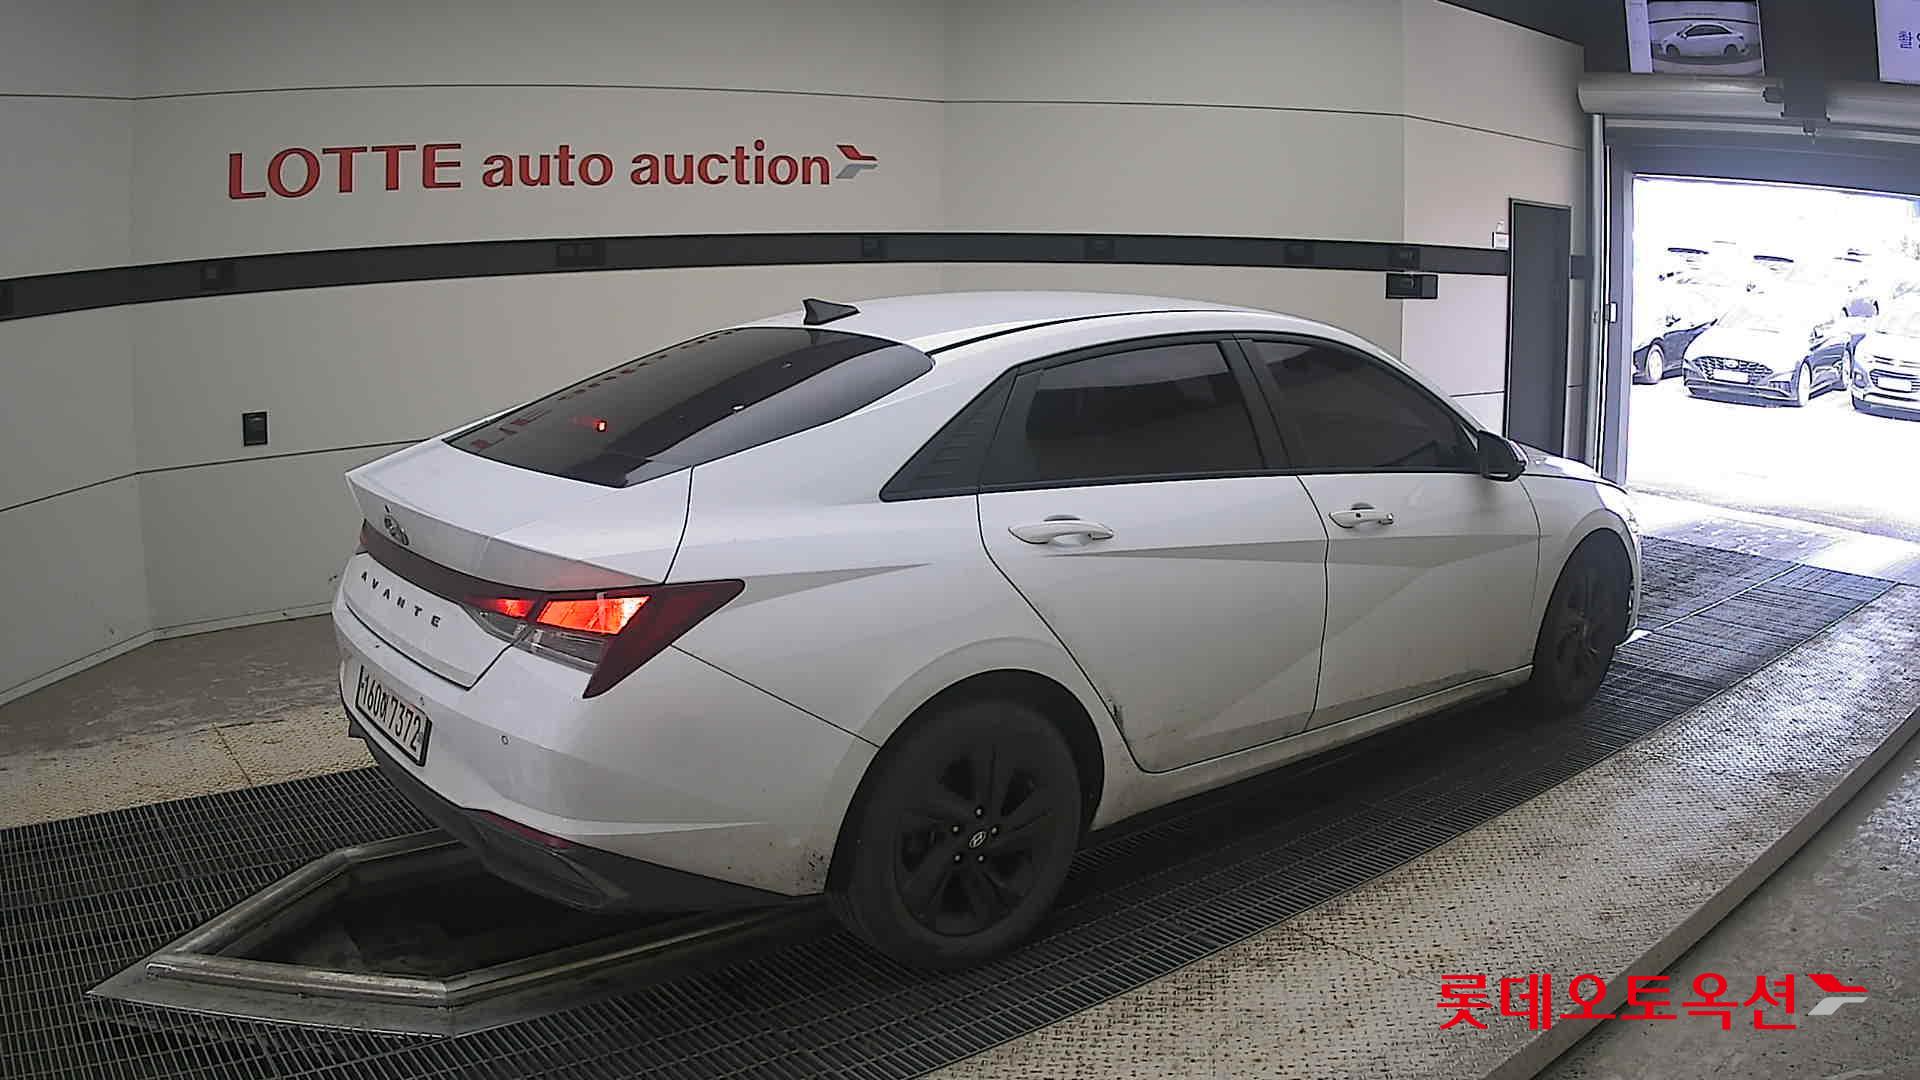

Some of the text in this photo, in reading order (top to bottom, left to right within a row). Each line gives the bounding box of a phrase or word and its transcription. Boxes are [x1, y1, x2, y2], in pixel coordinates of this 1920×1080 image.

[228, 140, 831, 199] LOTTE auto auction
[361, 571, 441, 628] AVANTE
